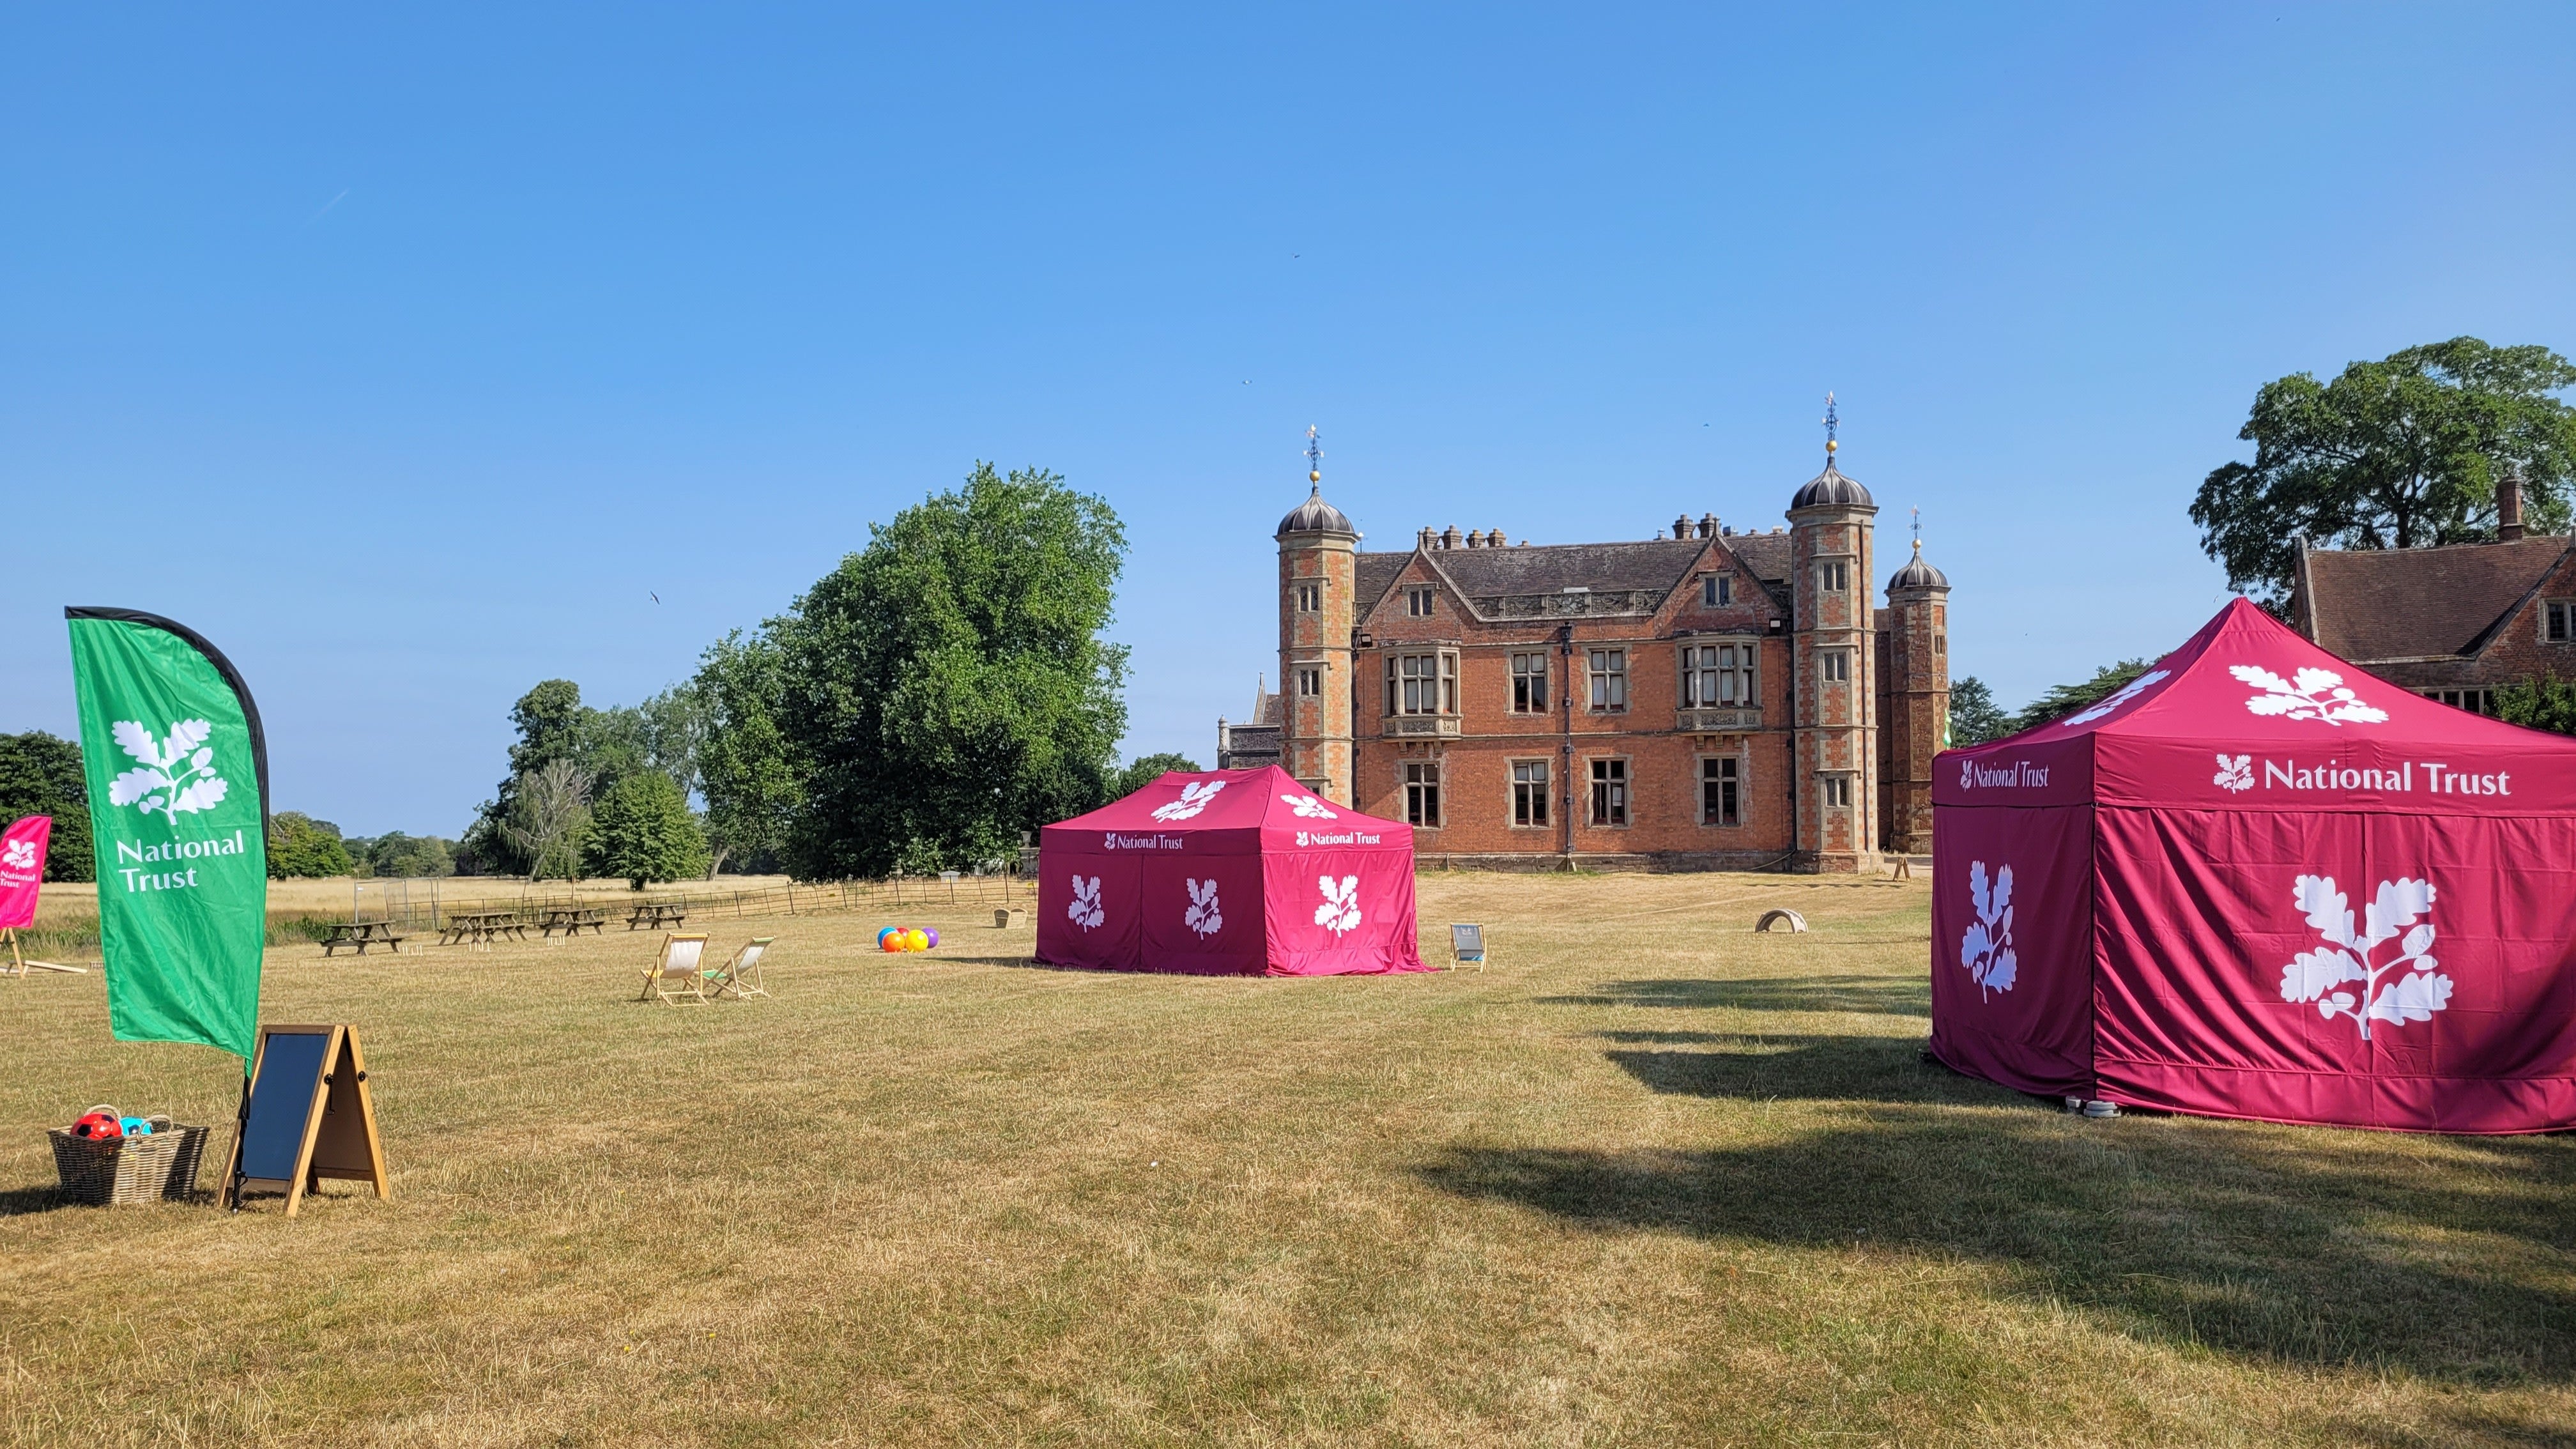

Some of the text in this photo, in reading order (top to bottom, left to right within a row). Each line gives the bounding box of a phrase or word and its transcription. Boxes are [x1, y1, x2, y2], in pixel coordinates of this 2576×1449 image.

[1974, 761, 2050, 788] National Trust
[2265, 759, 2511, 795] National Trust
[117, 830, 244, 864] National
[1117, 834, 1183, 850] National Trust
[1310, 831, 1381, 845] National Trust
[0, 878, 20, 888] Trust
[1, 870, 36, 882] National
[119, 867, 199, 893] Trust
